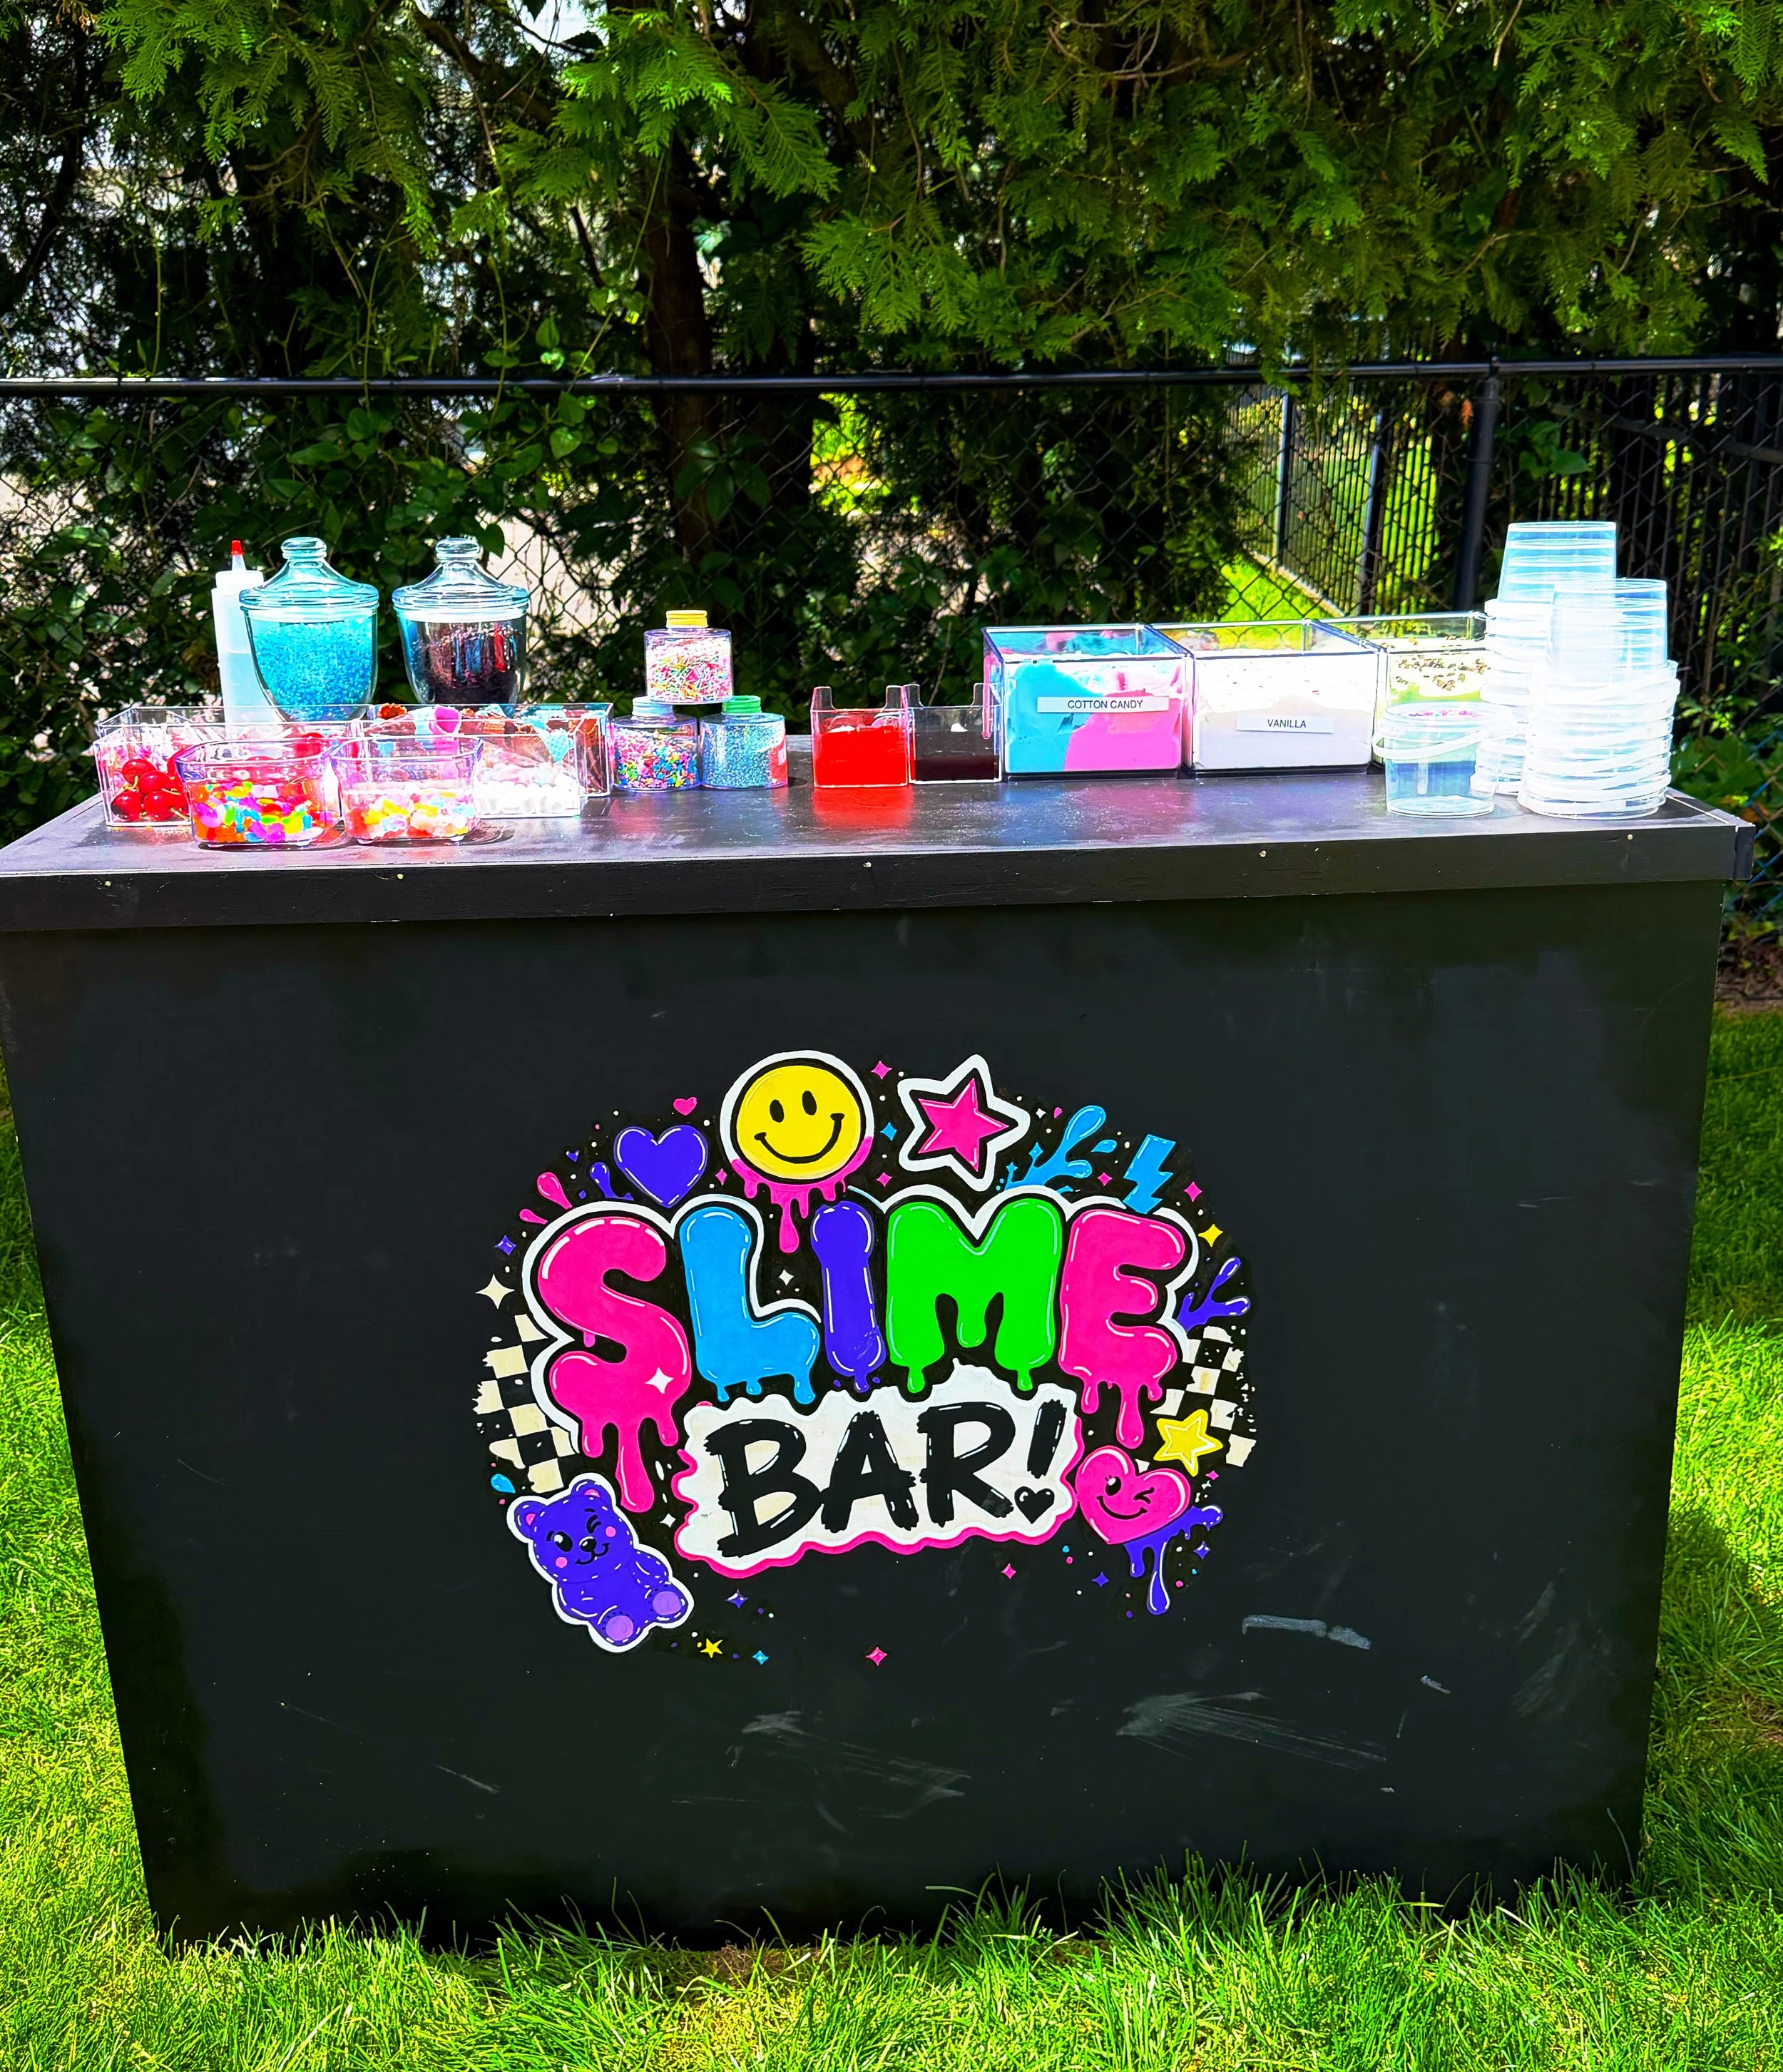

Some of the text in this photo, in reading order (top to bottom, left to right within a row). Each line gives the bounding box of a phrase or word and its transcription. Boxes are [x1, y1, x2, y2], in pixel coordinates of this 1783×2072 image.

[1068, 700, 1143, 709] COTTON CANDY
[1267, 719, 1307, 728] VANILLA
[537, 1195, 1186, 1512] SLIME
[703, 1398, 1067, 1558] BAR!
